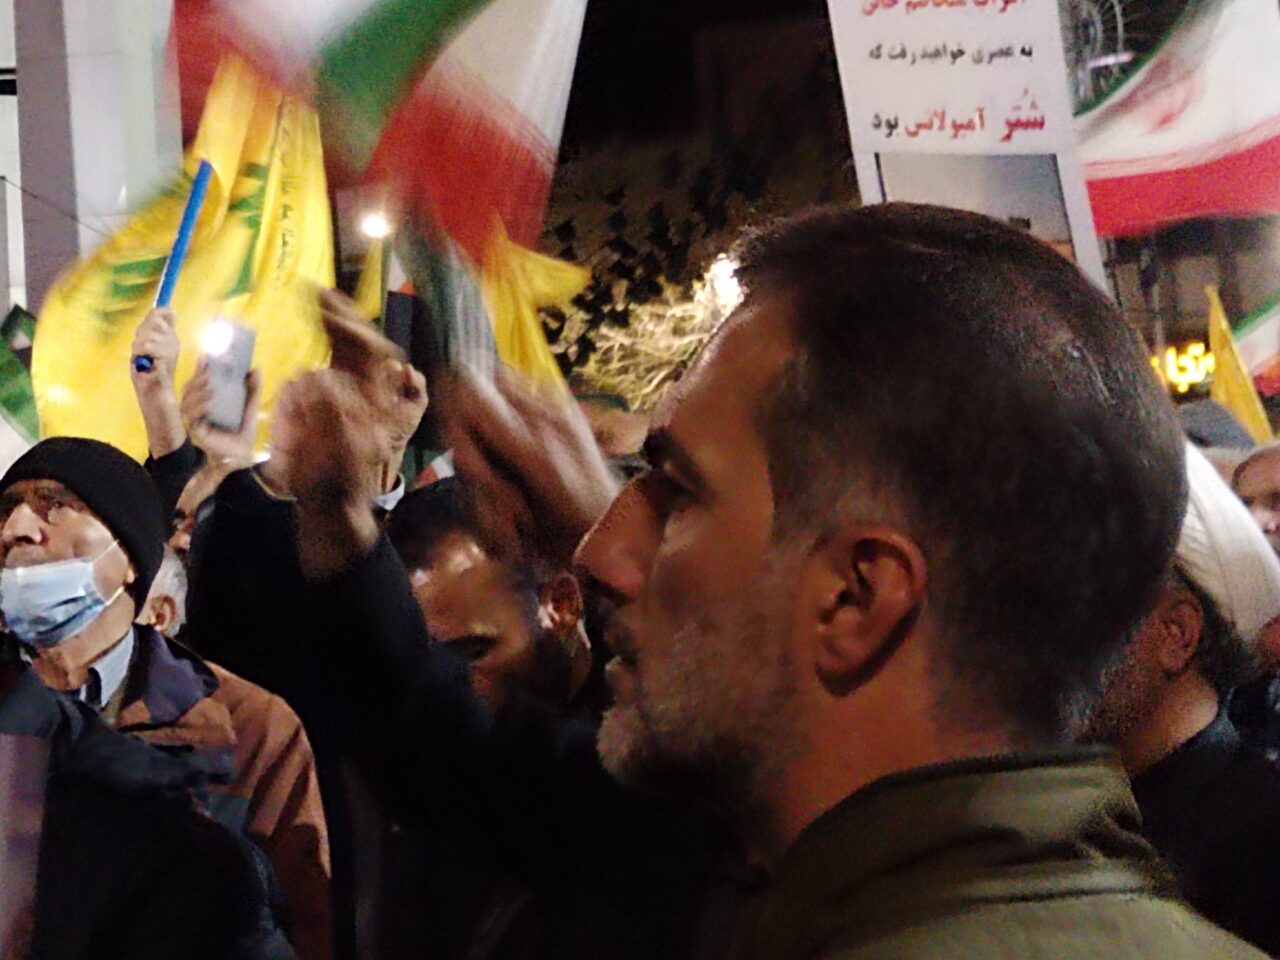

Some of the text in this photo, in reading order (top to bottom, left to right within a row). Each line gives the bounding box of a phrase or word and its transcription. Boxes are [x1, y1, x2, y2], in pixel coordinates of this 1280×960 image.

[868, 42, 883, 60] که
[1020, 44, 1033, 63] به
[872, 112, 899, 139] بود
